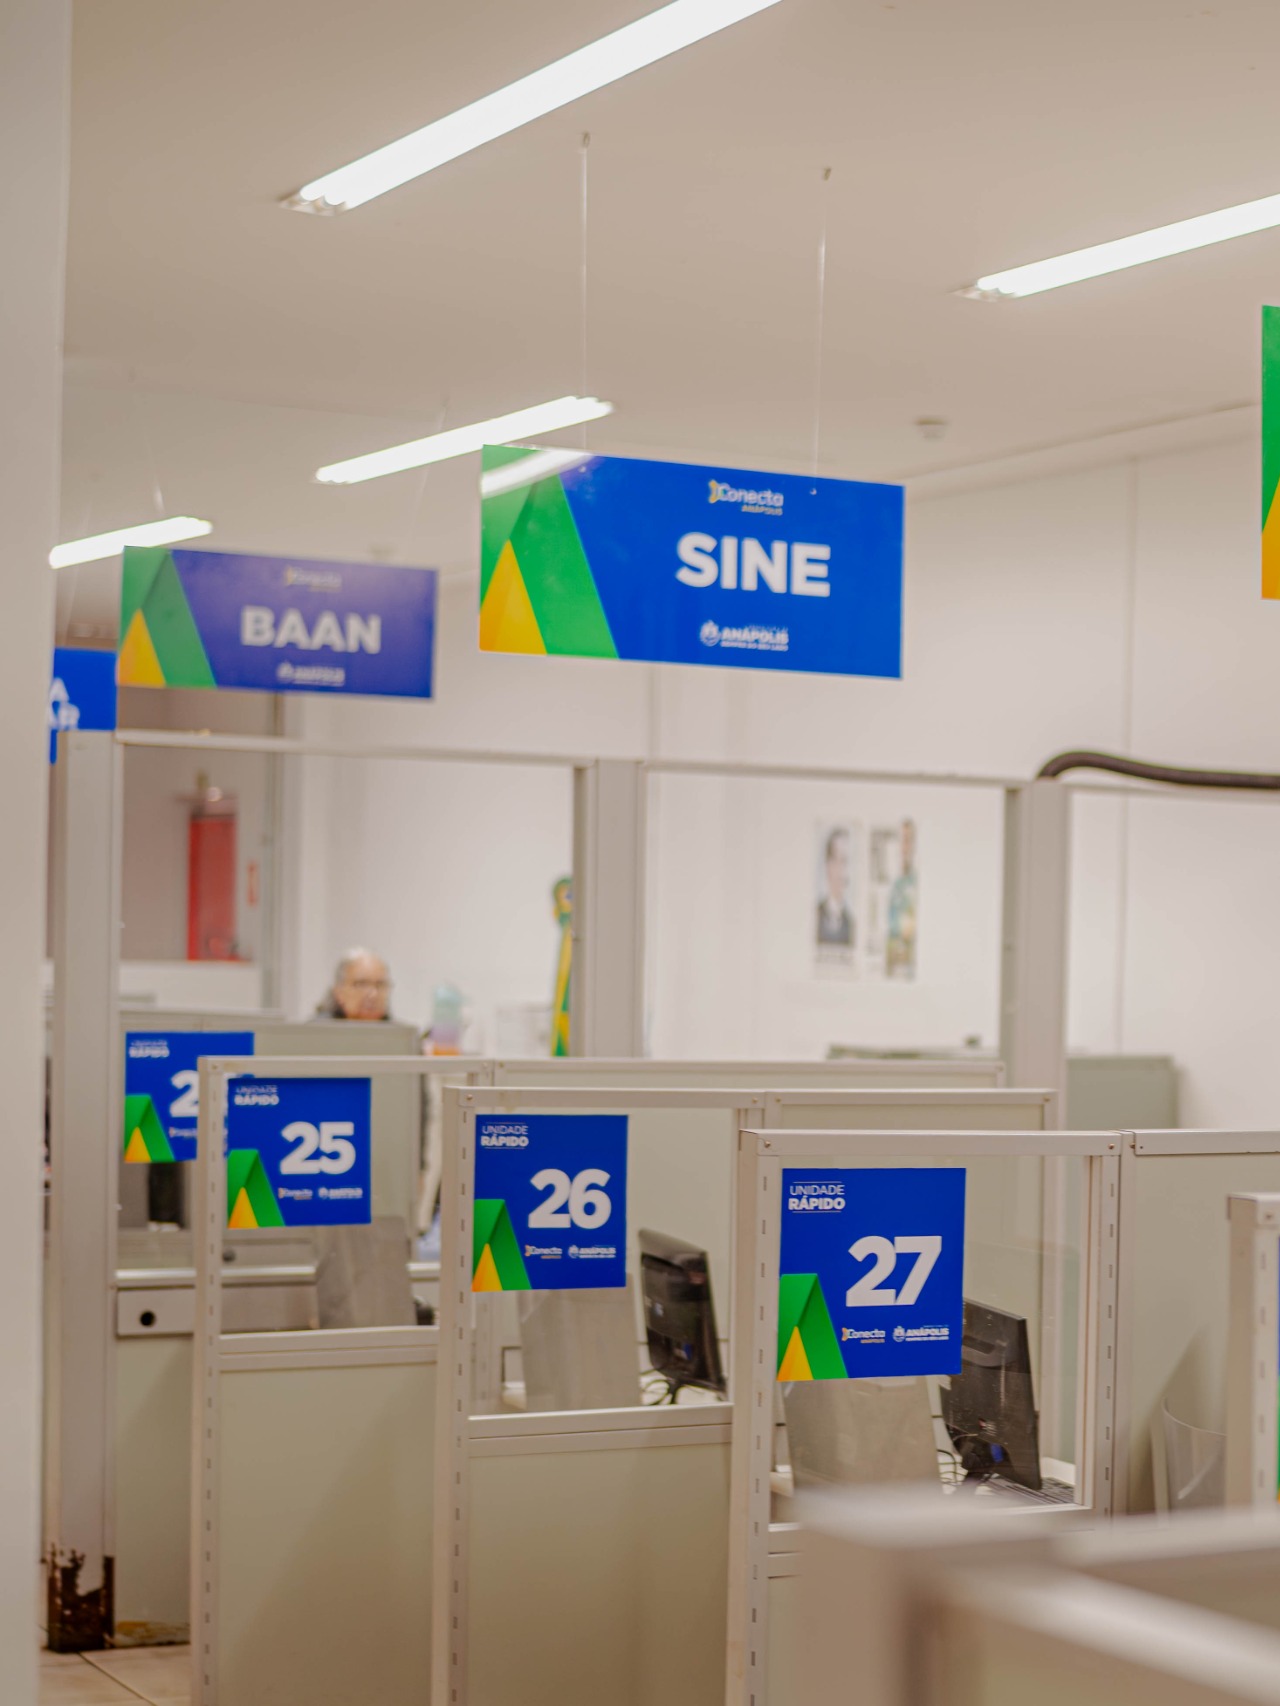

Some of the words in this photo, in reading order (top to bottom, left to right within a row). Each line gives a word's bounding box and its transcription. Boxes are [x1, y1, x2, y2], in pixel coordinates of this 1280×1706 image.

[717, 482, 784, 507] Conecta
[675, 531, 832, 598] SINE
[240, 604, 382, 656] BAAN
[234, 1092, 280, 1105] RÁPIDO
[480, 1134, 529, 1147] RÁPIDO
[482, 1125, 529, 1135] UNIDADE
[279, 1121, 357, 1175] 25
[528, 1168, 612, 1230] 26
[789, 1184, 846, 1196] UNIDADE
[788, 1195, 846, 1211] RÁPIDO
[845, 1235, 943, 1308] 27
